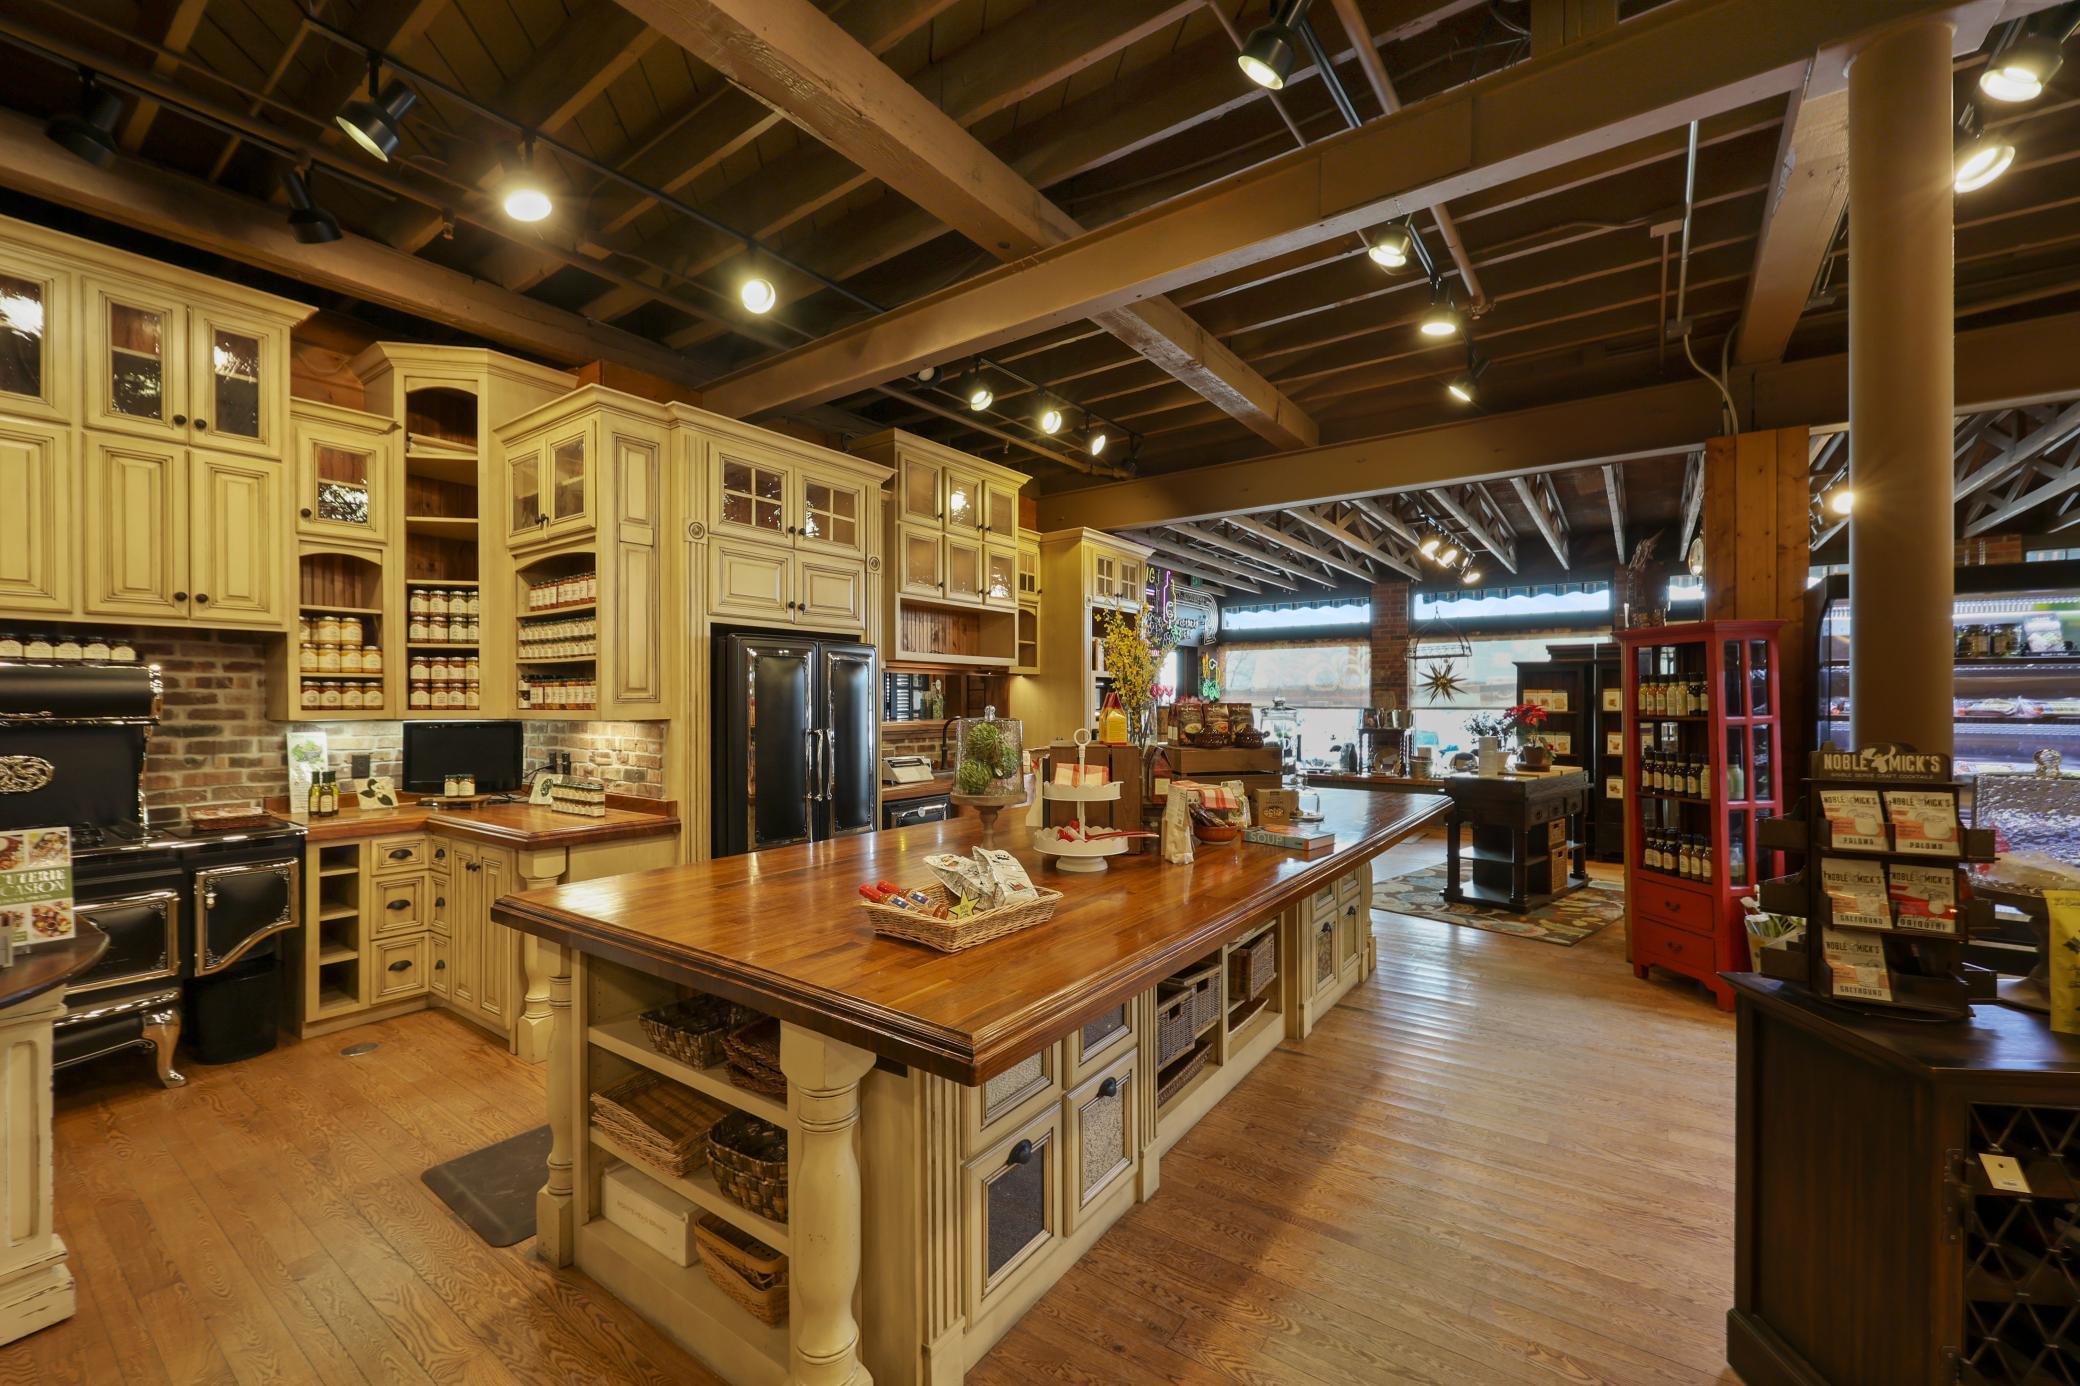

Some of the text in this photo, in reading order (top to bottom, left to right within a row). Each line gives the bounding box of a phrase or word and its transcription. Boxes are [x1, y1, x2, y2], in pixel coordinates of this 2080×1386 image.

[1824, 753, 1941, 773] NOBLE MICK'S
[1824, 796, 1877, 805] NOBLE MICK'S
[1892, 797, 1951, 807] NOBLE MICK'S
[1250, 831, 1285, 846] SOUP
[1, 869, 66, 885] UTERIE
[1828, 871, 1881, 885] NOBLE MICK'S
[1891, 871, 1951, 885] NOBLE MICK'S
[1826, 941, 1880, 954] NOBLE MICK'S
